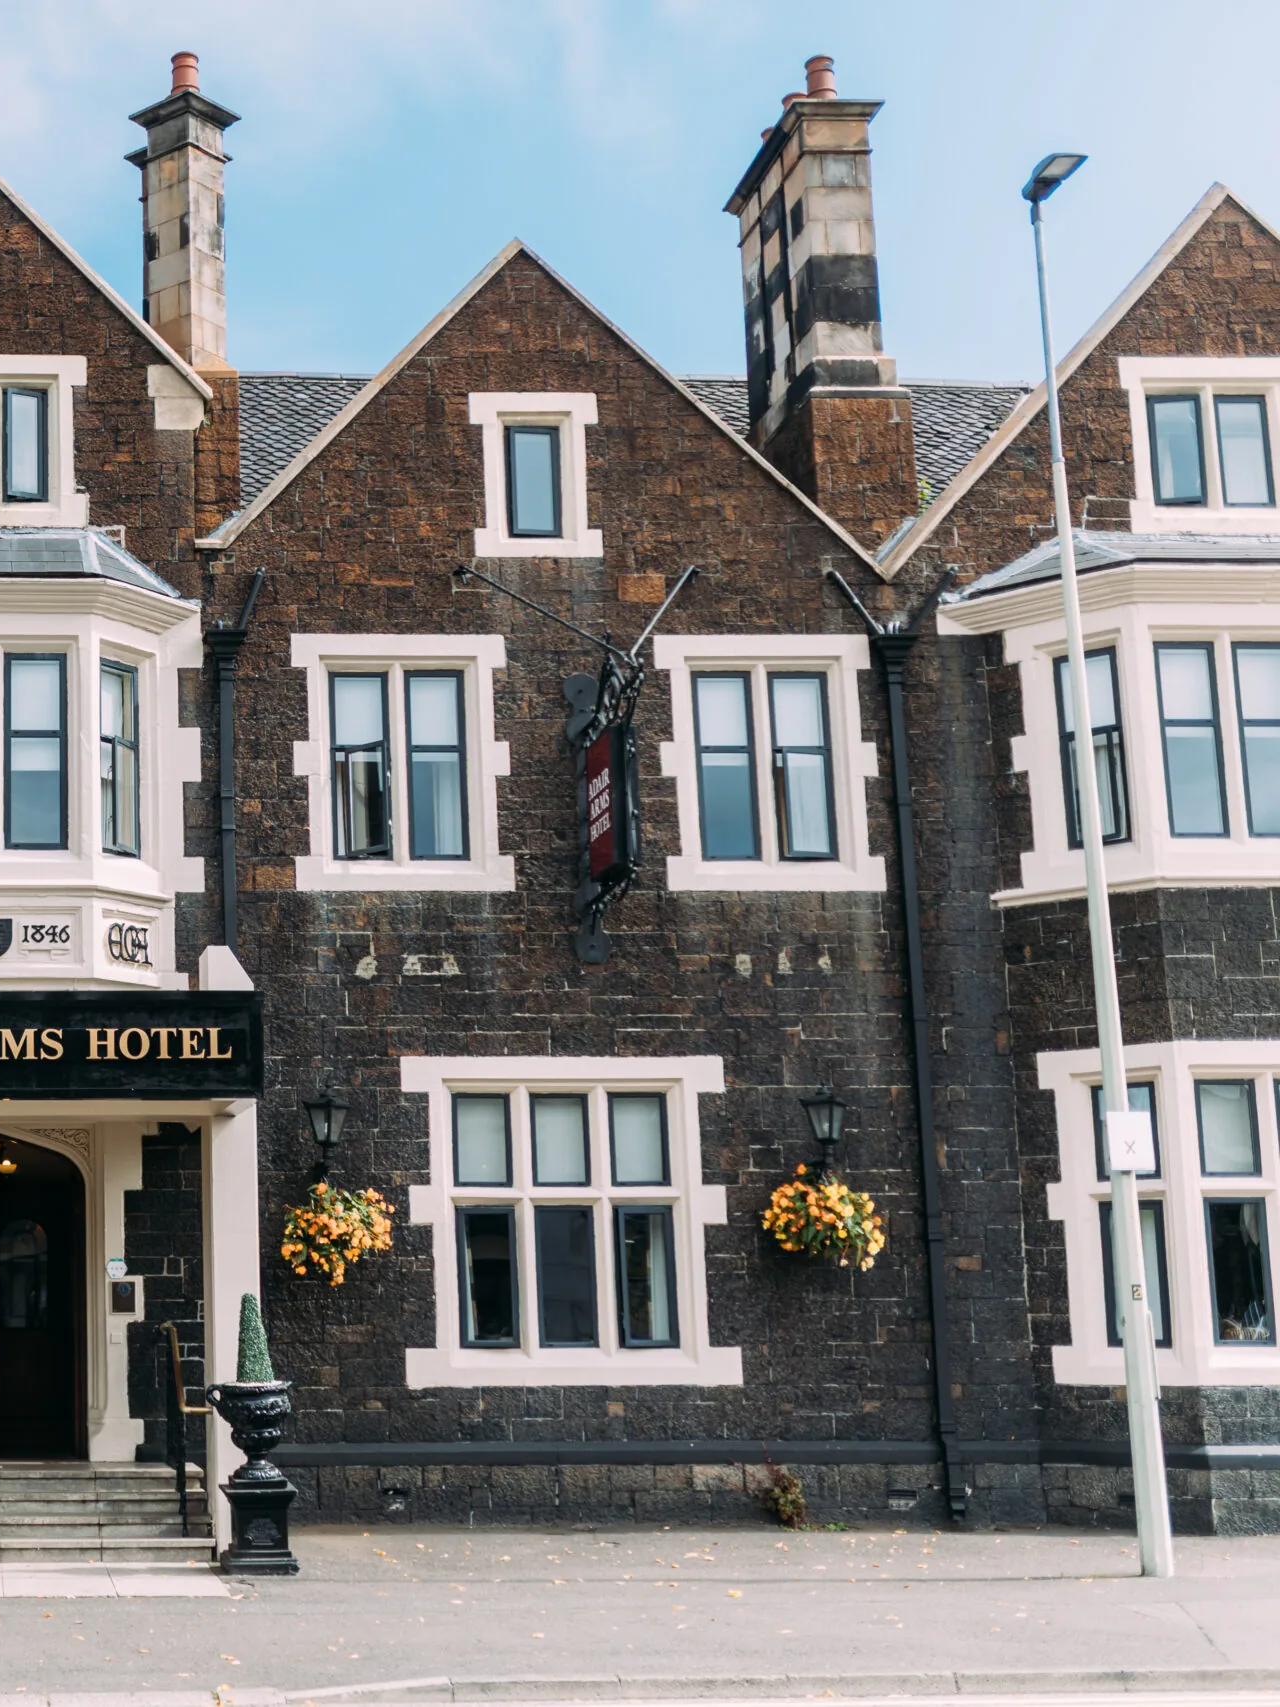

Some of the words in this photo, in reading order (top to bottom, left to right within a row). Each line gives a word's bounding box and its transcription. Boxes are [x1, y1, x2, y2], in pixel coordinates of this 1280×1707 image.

[588, 768, 610, 801] ADAIR
[590, 789, 610, 821] ARMS
[590, 812, 611, 842] HOTEL
[22, 925, 70, 943] 1846
[86, 1027, 232, 1060] HOTEL
